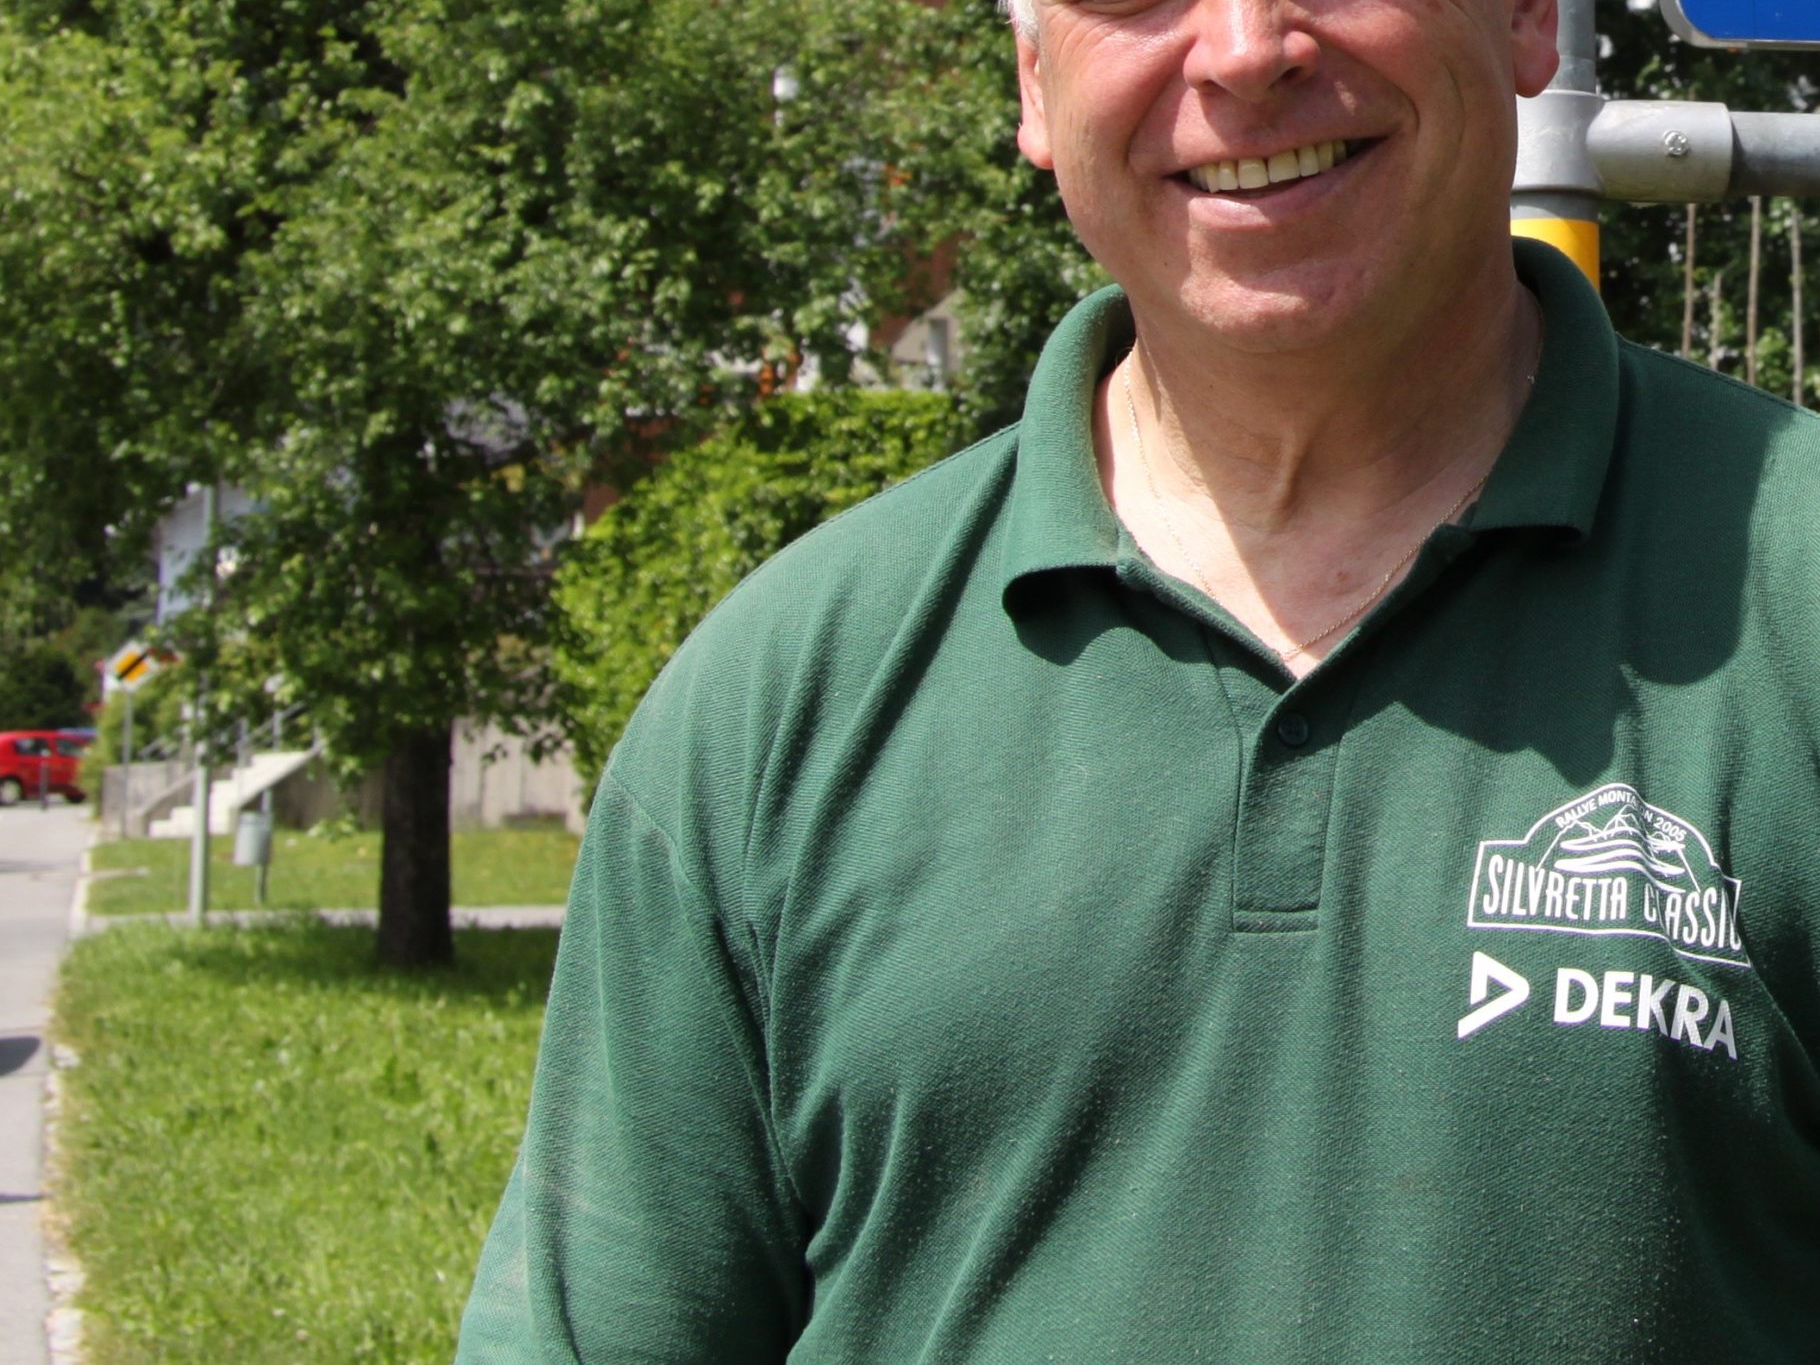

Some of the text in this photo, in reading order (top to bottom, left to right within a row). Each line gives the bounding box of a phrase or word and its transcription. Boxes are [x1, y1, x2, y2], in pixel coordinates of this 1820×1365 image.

[1555, 798, 1597, 828] RALLYE
[1653, 817, 1687, 842] 2005
[1483, 854, 1629, 922] SILVRETTA
[1553, 967, 1738, 1061] DEKRA
